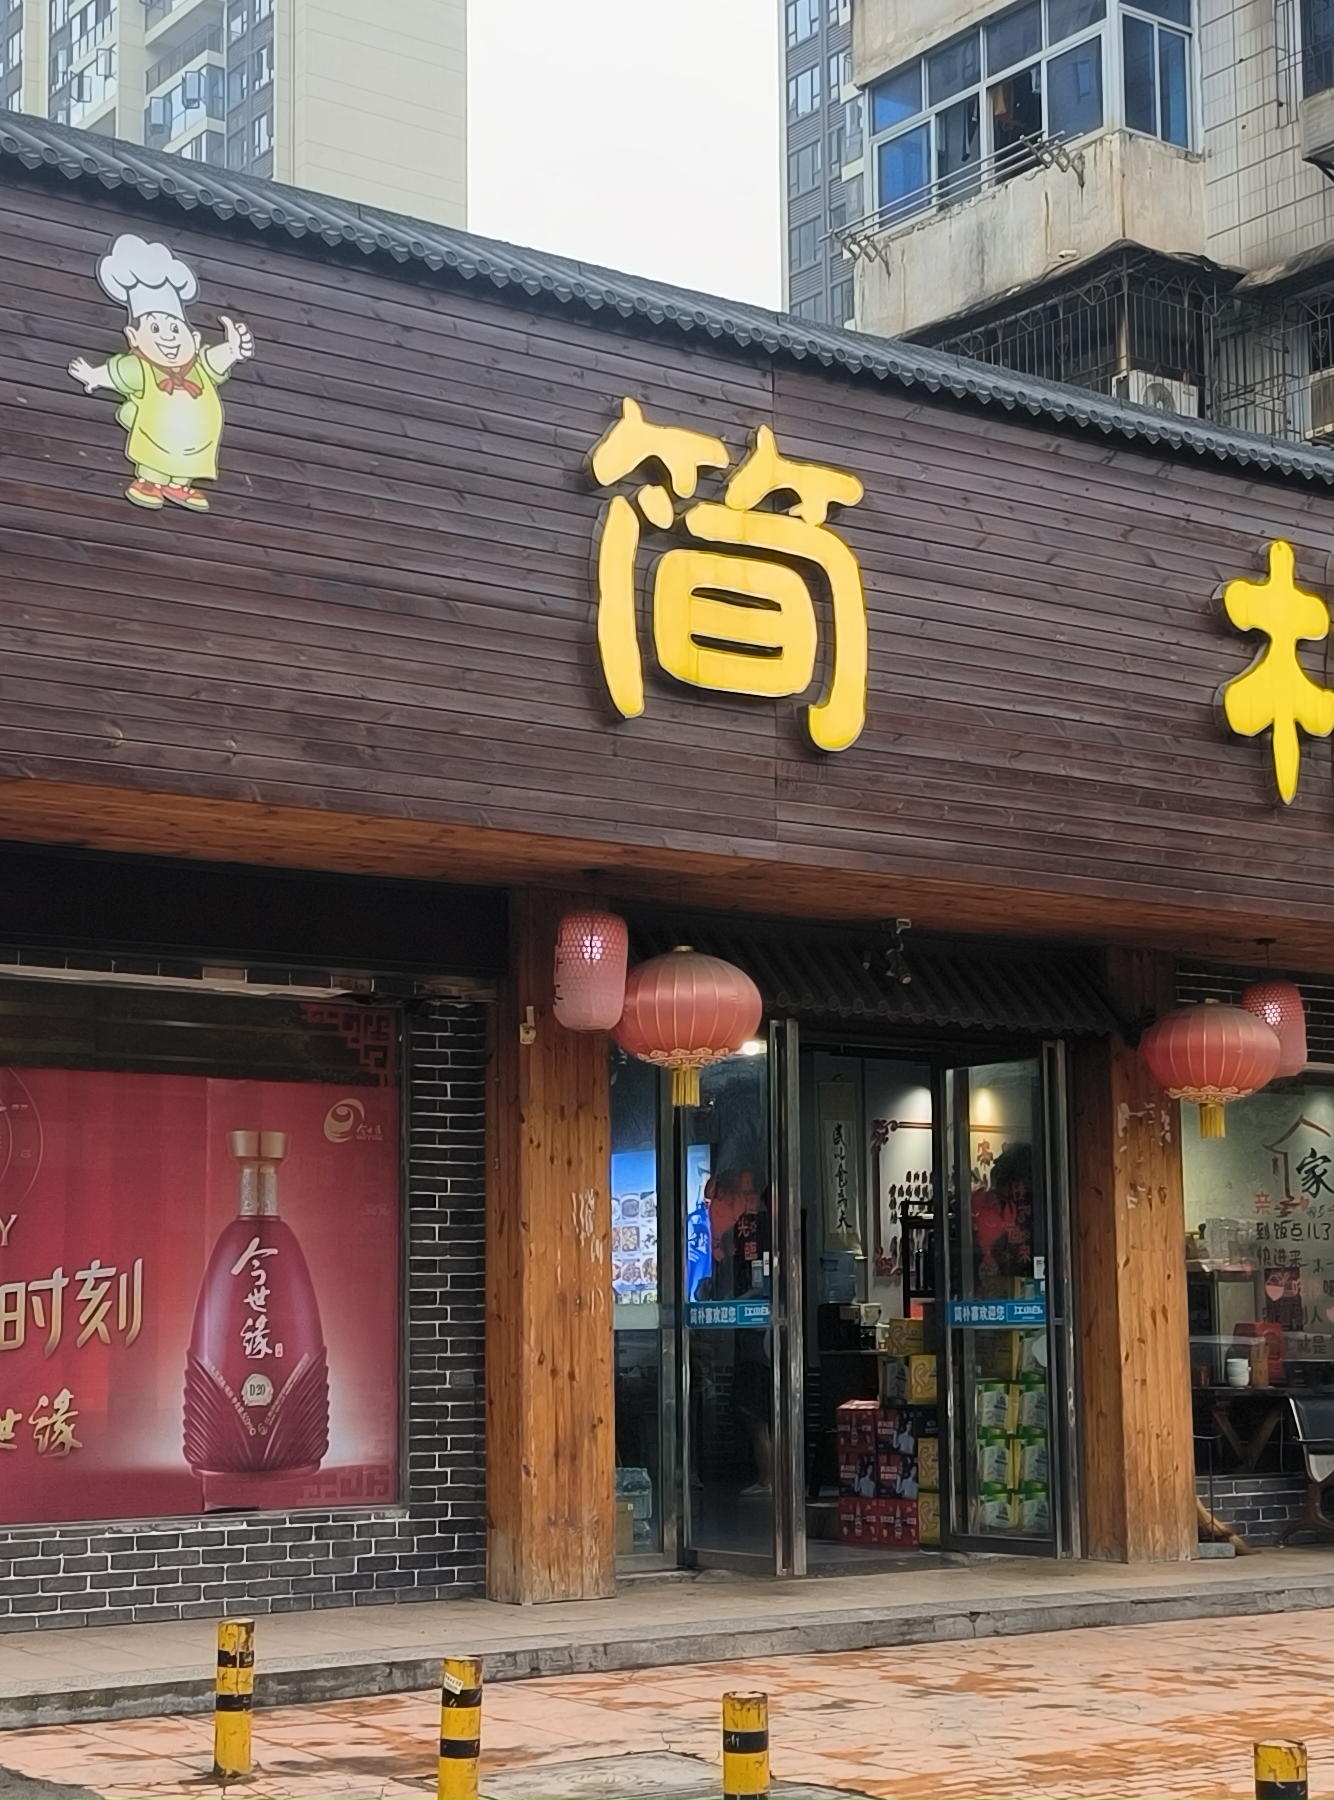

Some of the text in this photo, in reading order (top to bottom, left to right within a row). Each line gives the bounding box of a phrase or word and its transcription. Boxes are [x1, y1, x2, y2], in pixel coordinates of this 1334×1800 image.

[1255, 1222, 1331, 1242] 到饭点儿了
[231, 1237, 278, 1359] 今世缘
